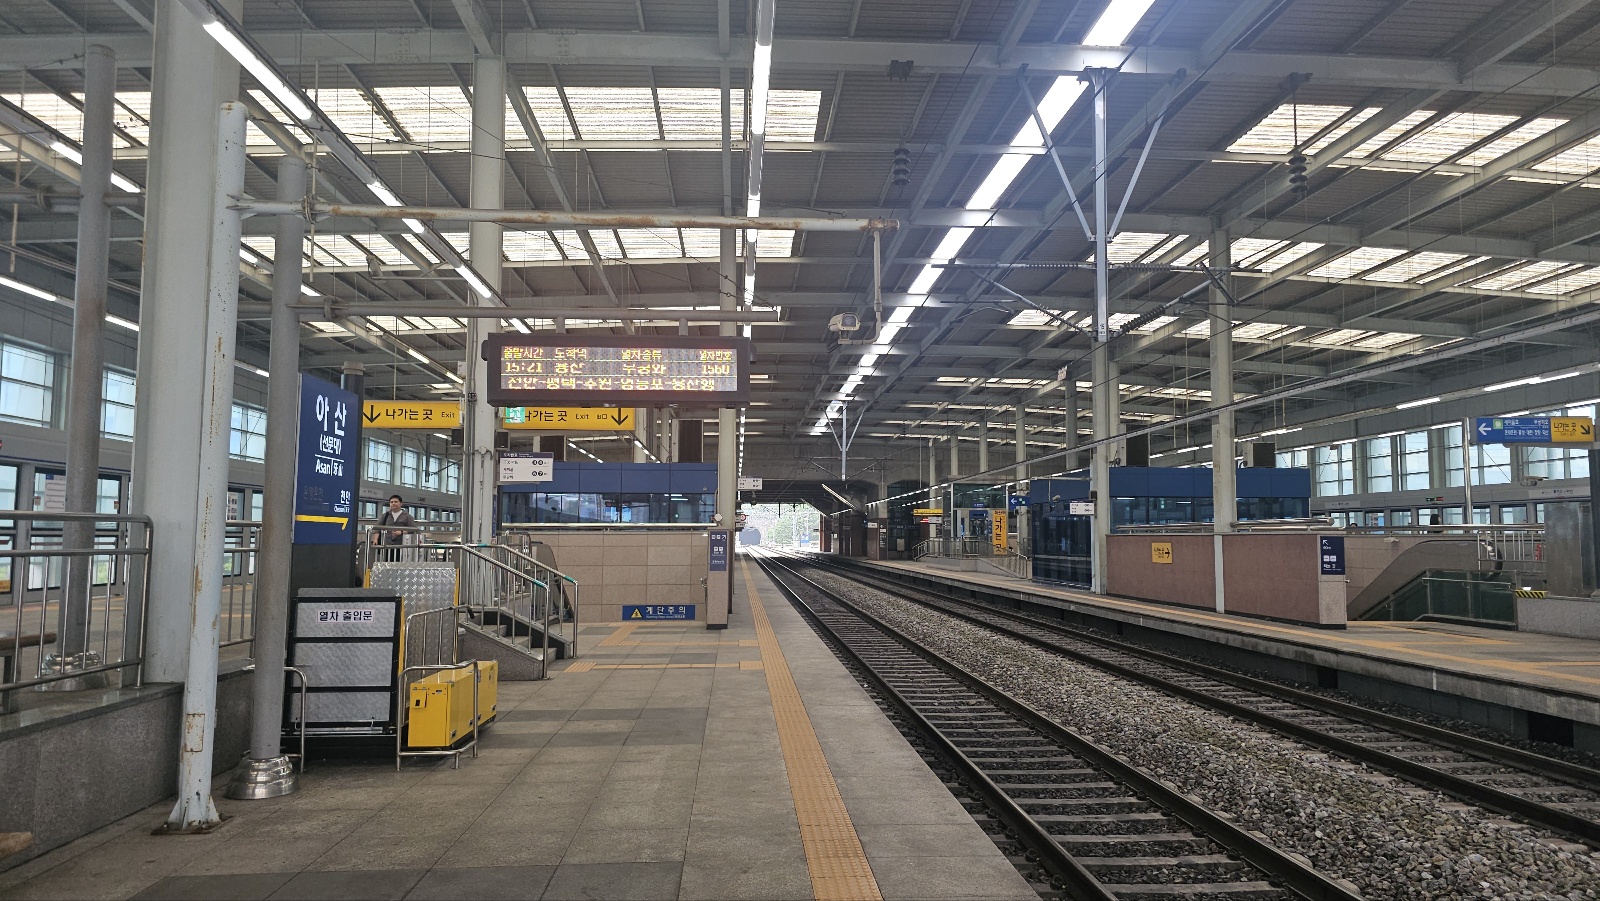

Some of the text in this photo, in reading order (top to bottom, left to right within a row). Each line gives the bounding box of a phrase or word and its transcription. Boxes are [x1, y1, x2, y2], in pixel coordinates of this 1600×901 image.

[505, 362, 543, 372] 15:21
[385, 408, 418, 420] 나가는
[423, 408, 433, 420] 곳
[557, 410, 568, 421] 곳
[575, 412, 589, 420] Exit
[315, 458, 331, 475] Asan
[319, 610, 373, 621] 열차 출입문
